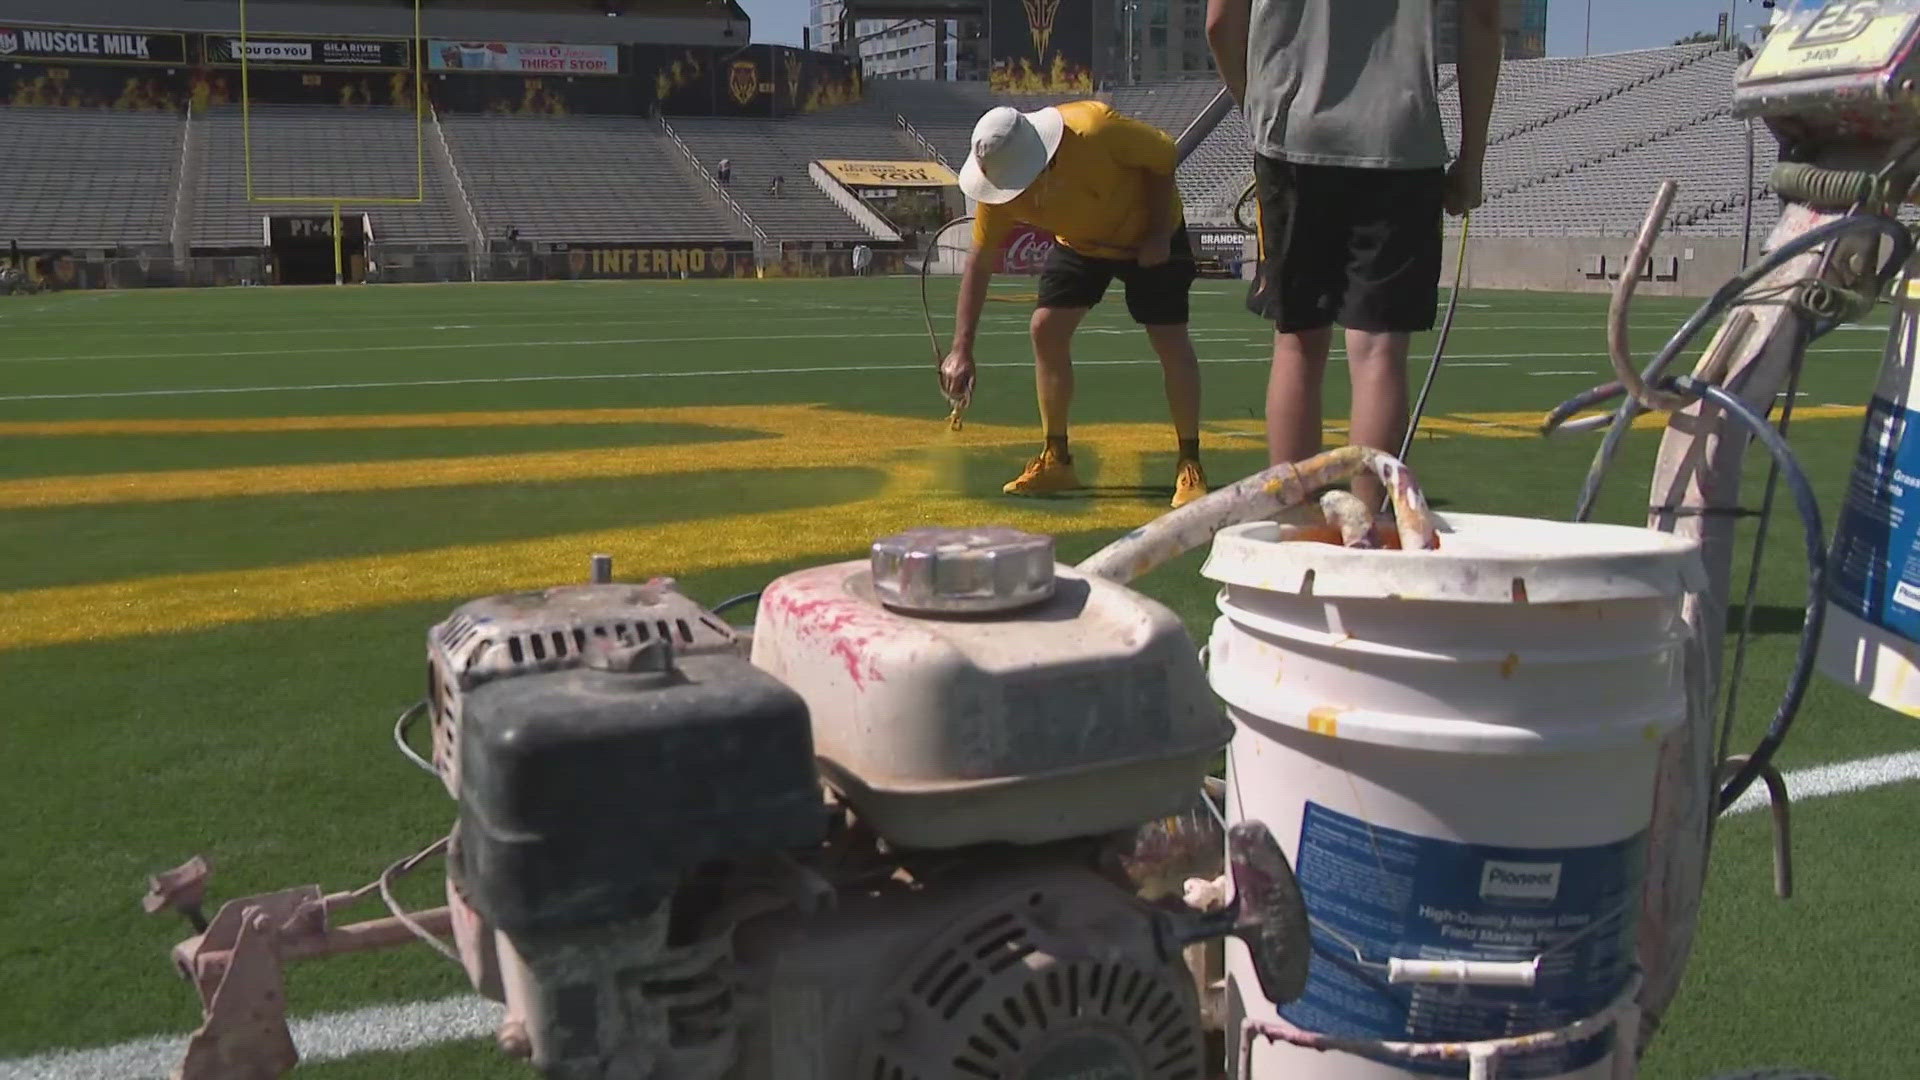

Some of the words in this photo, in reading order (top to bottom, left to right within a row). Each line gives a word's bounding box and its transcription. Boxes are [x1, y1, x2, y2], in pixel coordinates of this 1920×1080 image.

[22, 30, 99, 54] MUSCLE
[103, 34, 149, 56] MILK
[265, 47, 281, 55] DO
[284, 48, 307, 56] YOU
[323, 43, 348, 52] GILA
[350, 44, 380, 53] RIVER
[520, 58, 566, 70] THIRST
[570, 59, 607, 70] STOP!
[1200, 233, 1244, 245] BRANDED
[592, 249, 705, 272] INFERNO
[1489, 868, 1553, 885] Pioneer
[1419, 904, 1506, 928] High-Quality
[1441, 925, 1476, 941] Field
[1480, 930, 1534, 945] Marking
